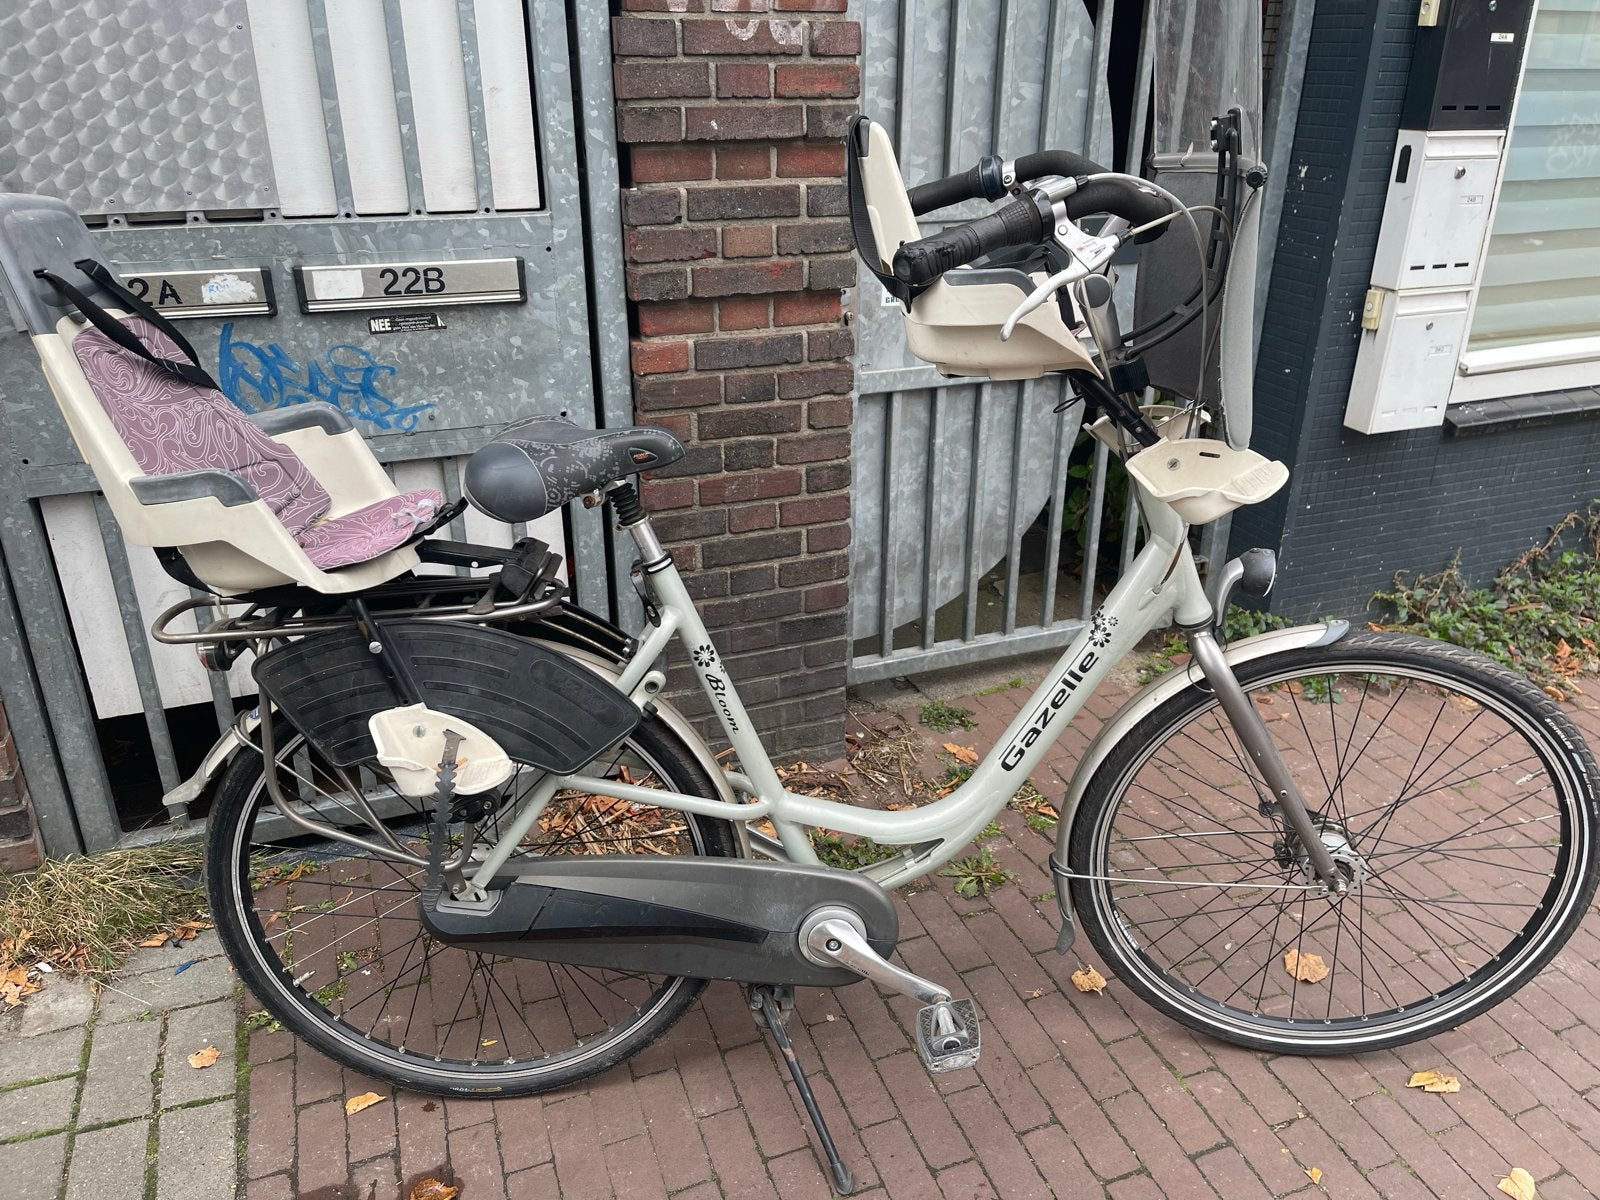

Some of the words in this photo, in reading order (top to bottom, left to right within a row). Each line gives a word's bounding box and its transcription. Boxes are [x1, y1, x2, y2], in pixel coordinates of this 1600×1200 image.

[127, 277, 184, 306] 2A
[379, 267, 446, 296] 22B
[370, 318, 392, 332] NEE
[705, 673, 740, 735] Bloom
[1001, 651, 1100, 772] Gazelle
